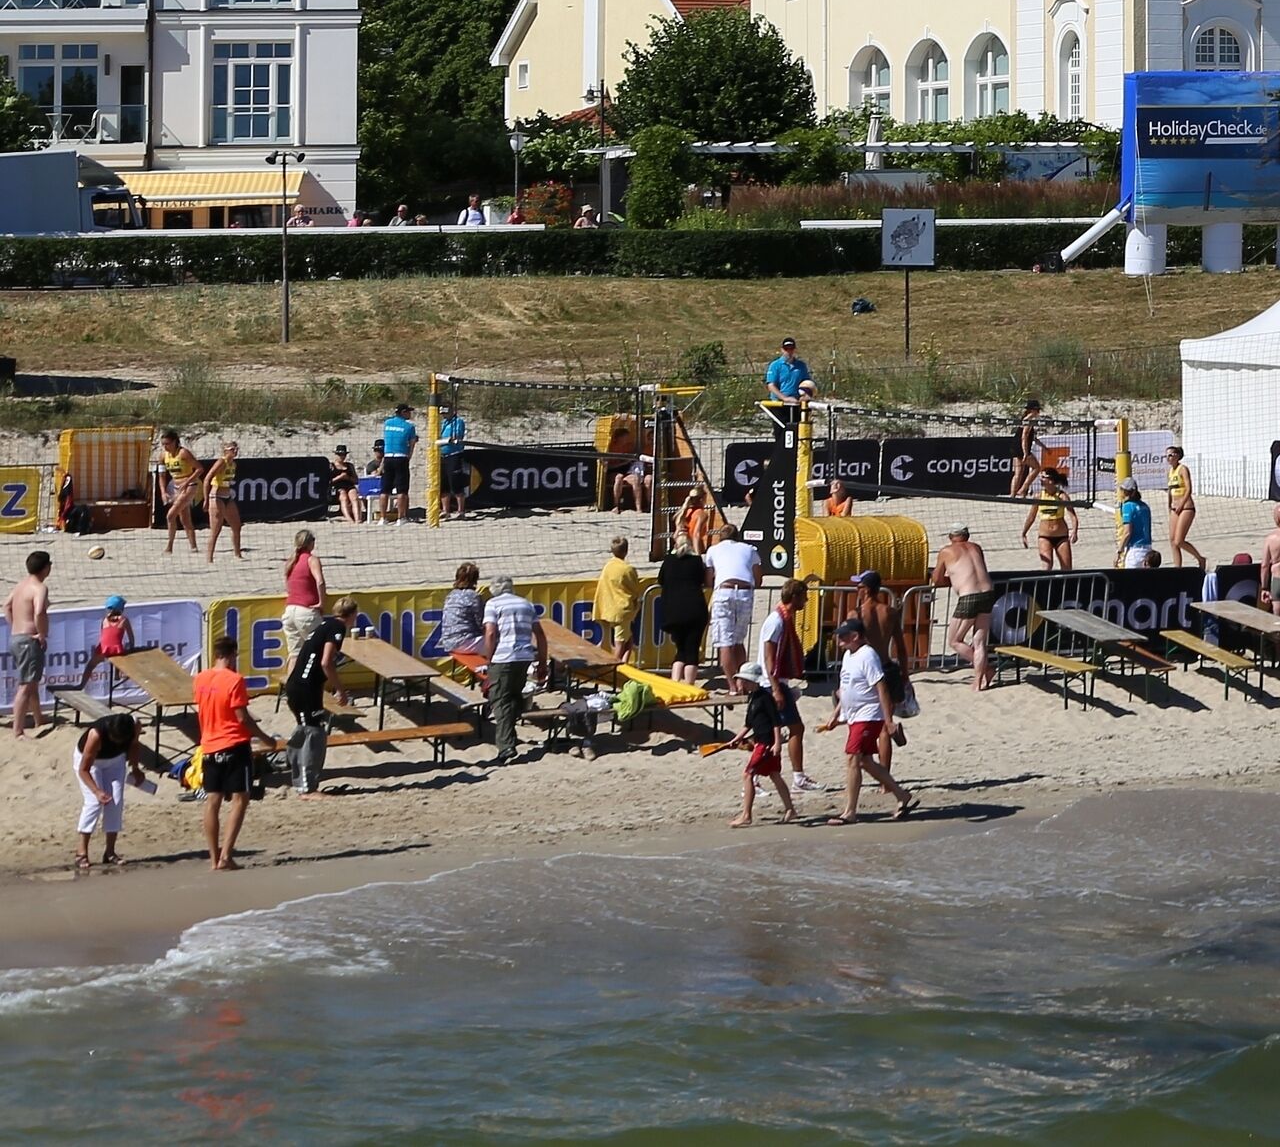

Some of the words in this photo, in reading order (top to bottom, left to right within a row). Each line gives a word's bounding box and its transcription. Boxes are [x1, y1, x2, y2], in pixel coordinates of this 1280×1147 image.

[1149, 119, 1268, 141] HolidayCheck.de
[490, 461, 588, 491] smart
[772, 480, 786, 542] smart
